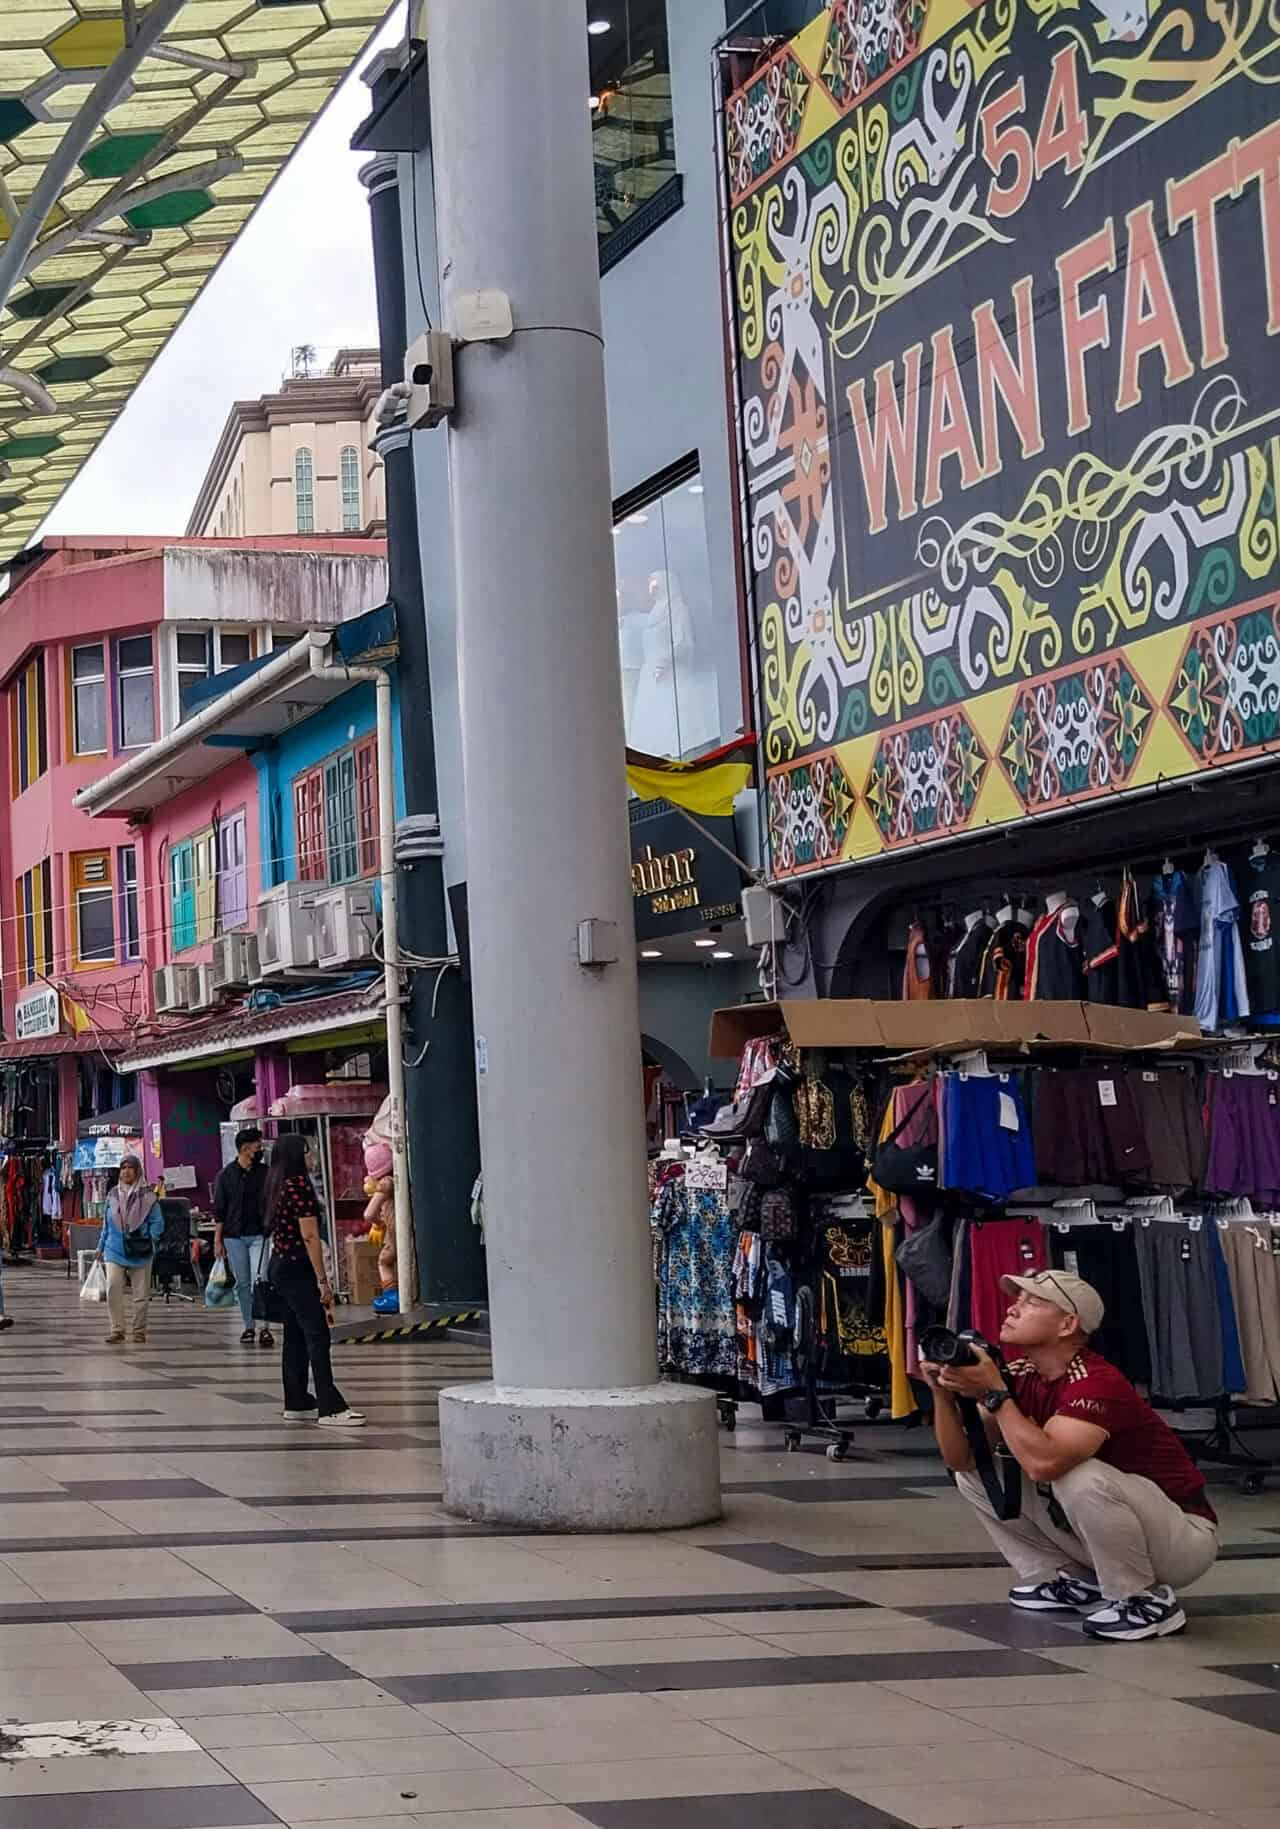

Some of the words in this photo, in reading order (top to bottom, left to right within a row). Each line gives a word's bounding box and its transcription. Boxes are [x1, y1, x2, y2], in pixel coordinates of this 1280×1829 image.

[980, 42, 1089, 218] 54
[846, 276, 1044, 535] WAN
[1055, 119, 1280, 436] FATT
[770, 1288, 789, 1328] NIKE
